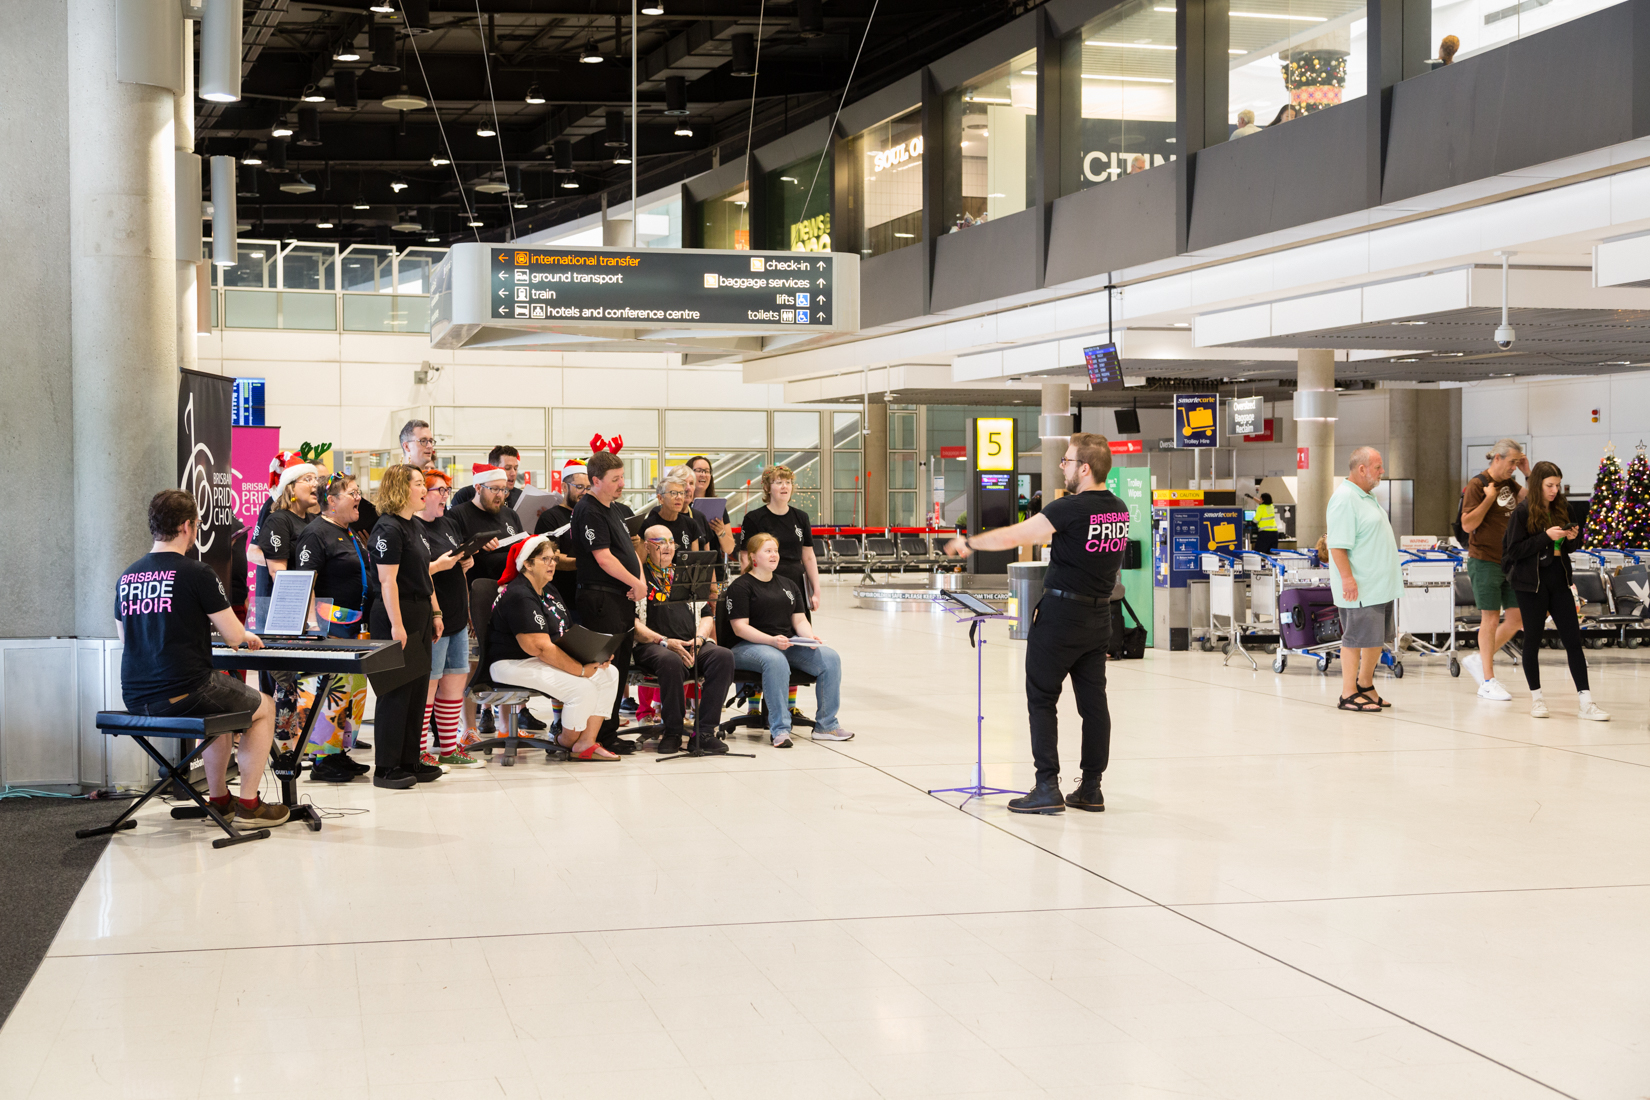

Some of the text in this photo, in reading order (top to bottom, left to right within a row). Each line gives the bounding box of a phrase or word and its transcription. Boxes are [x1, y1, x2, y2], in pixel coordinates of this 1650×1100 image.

[874, 143, 909, 172] SOUL
[531, 253, 640, 267] international transfer
[766, 259, 810, 271] check-in
[531, 272, 623, 285] ground transport
[719, 276, 810, 288] baggage services
[531, 289, 556, 299] train
[776, 294, 795, 305] lifts
[547, 306, 700, 319] hotels and conference centre
[747, 309, 779, 320] toilets
[1233, 400, 1256, 411] Oversized
[1234, 413, 1255, 424] Baggage
[1235, 424, 1254, 434] Reclaim
[988, 432, 1002, 457] 5
[1127, 478, 1143, 488] Trolley
[1127, 489, 1142, 499] Wipes
[242, 504, 263, 515] CH
[1090, 511, 1130, 524] BRISBANE
[1087, 522, 1130, 540] PRIDE
[120, 570, 177, 585] BRISBANE
[120, 580, 174, 602] PRIDE
[121, 597, 172, 616] CHOIR
